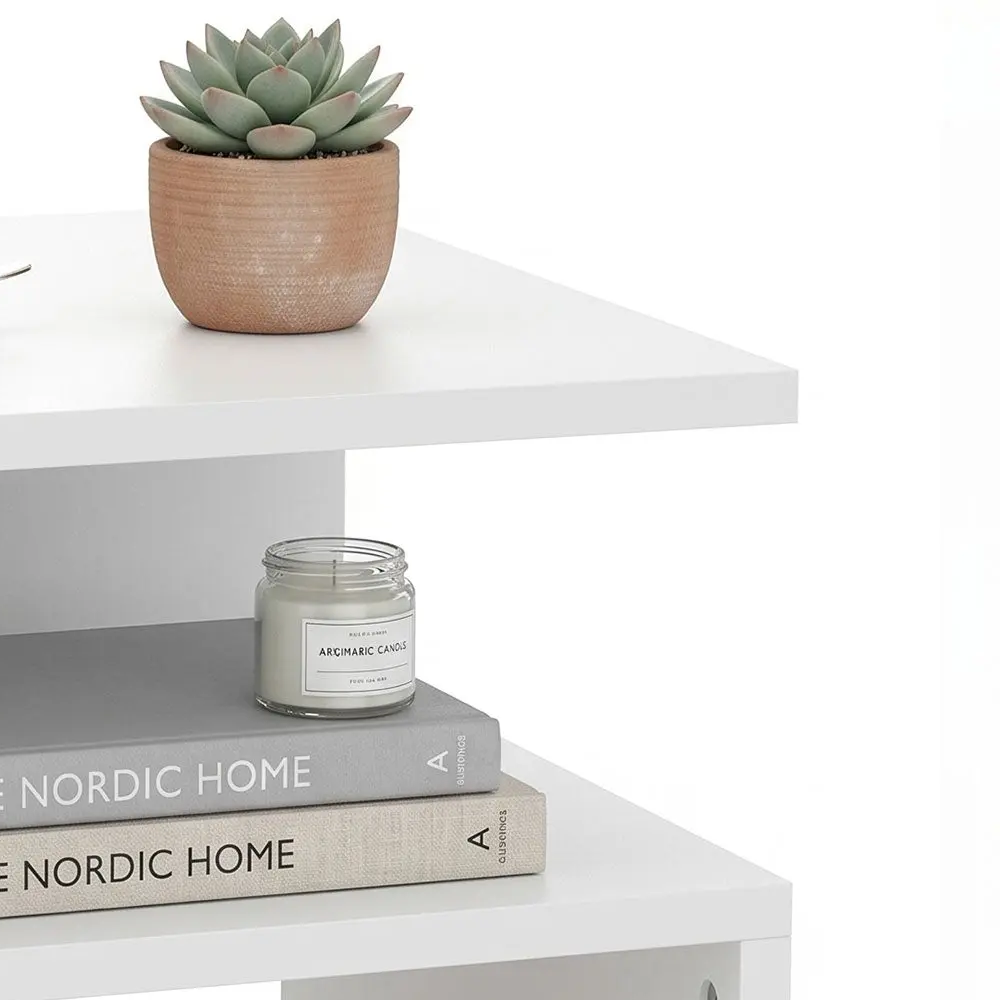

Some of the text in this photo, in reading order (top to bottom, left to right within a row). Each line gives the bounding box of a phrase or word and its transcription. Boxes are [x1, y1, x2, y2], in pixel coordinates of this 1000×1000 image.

[427, 750, 449, 773] A
[22, 765, 181, 809] NORDIC
[198, 755, 311, 796] HOME
[467, 827, 490, 850] A
[23, 848, 174, 891] NORDIC
[187, 838, 295, 876] HOME
